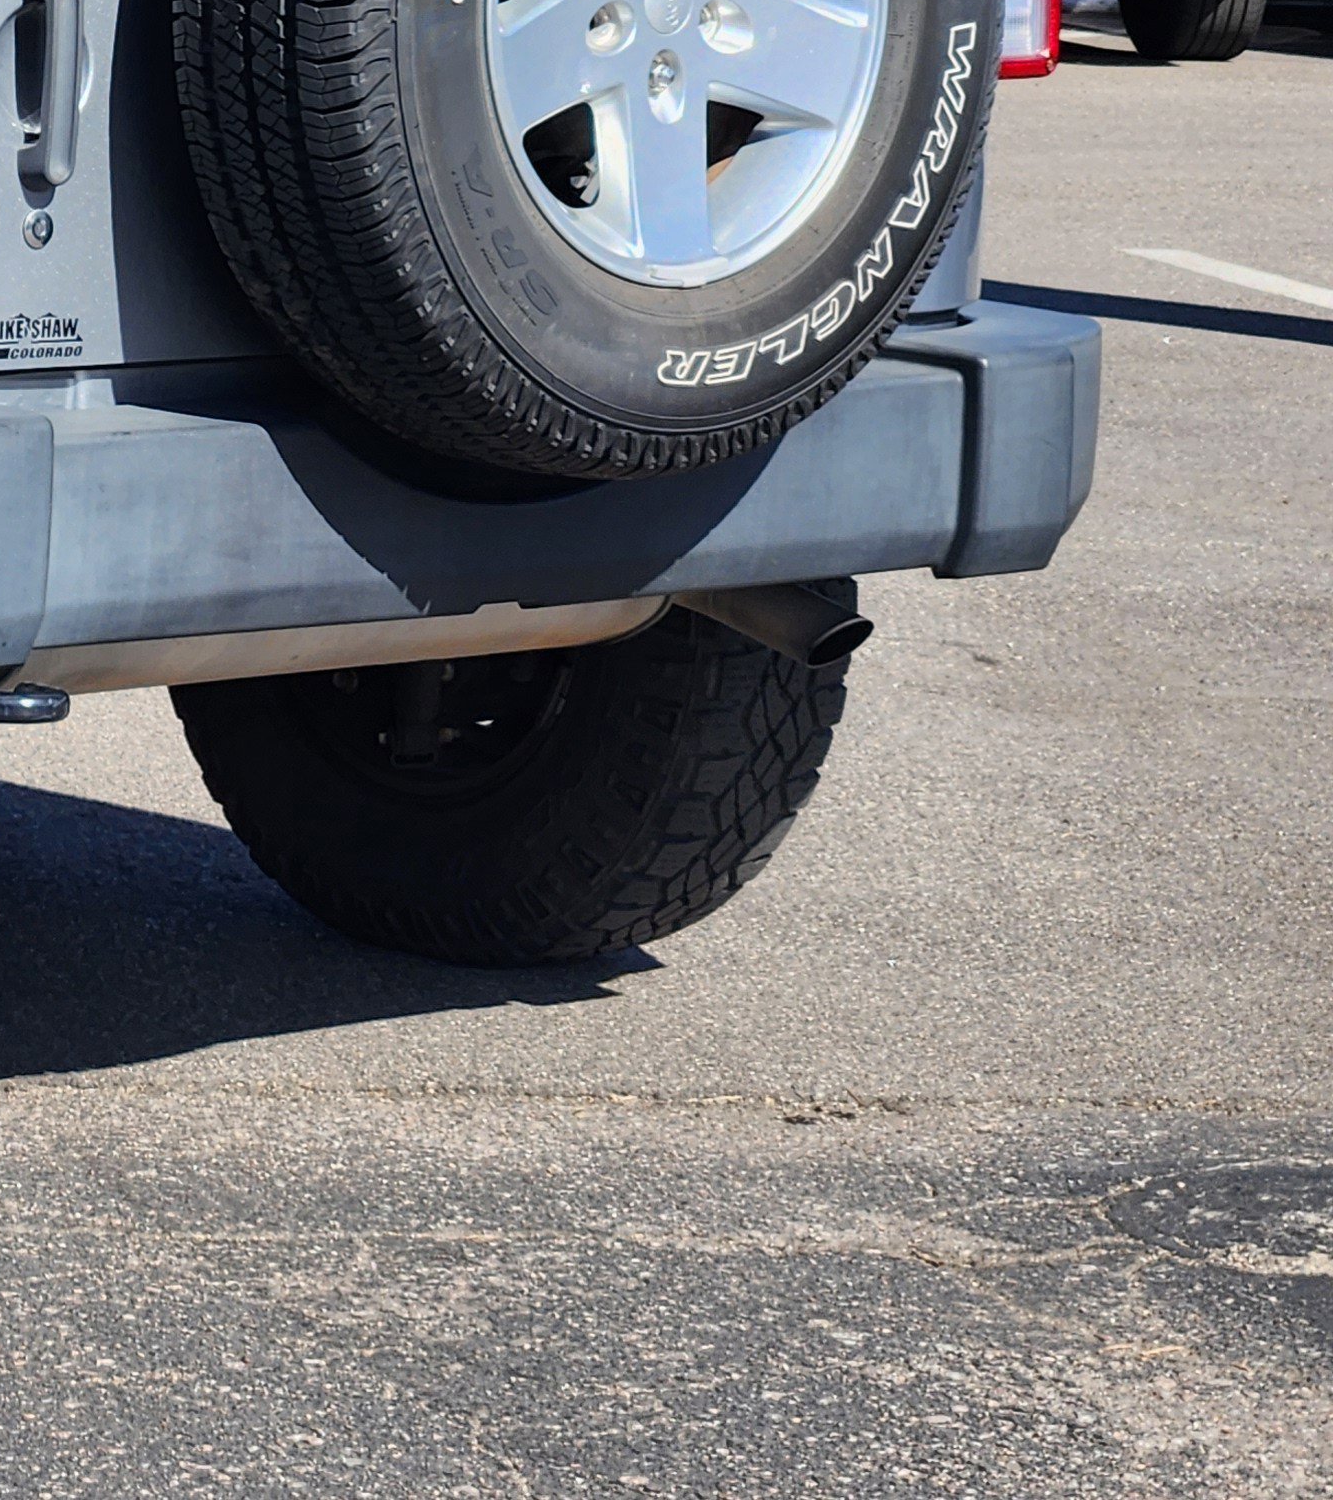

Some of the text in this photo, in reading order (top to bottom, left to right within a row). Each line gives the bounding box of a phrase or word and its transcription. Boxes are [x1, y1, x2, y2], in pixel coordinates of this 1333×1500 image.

[657, 21, 976, 387] WRANGLER
[30, 317, 79, 339] SHAW
[10, 345, 84, 359] COLORADO
